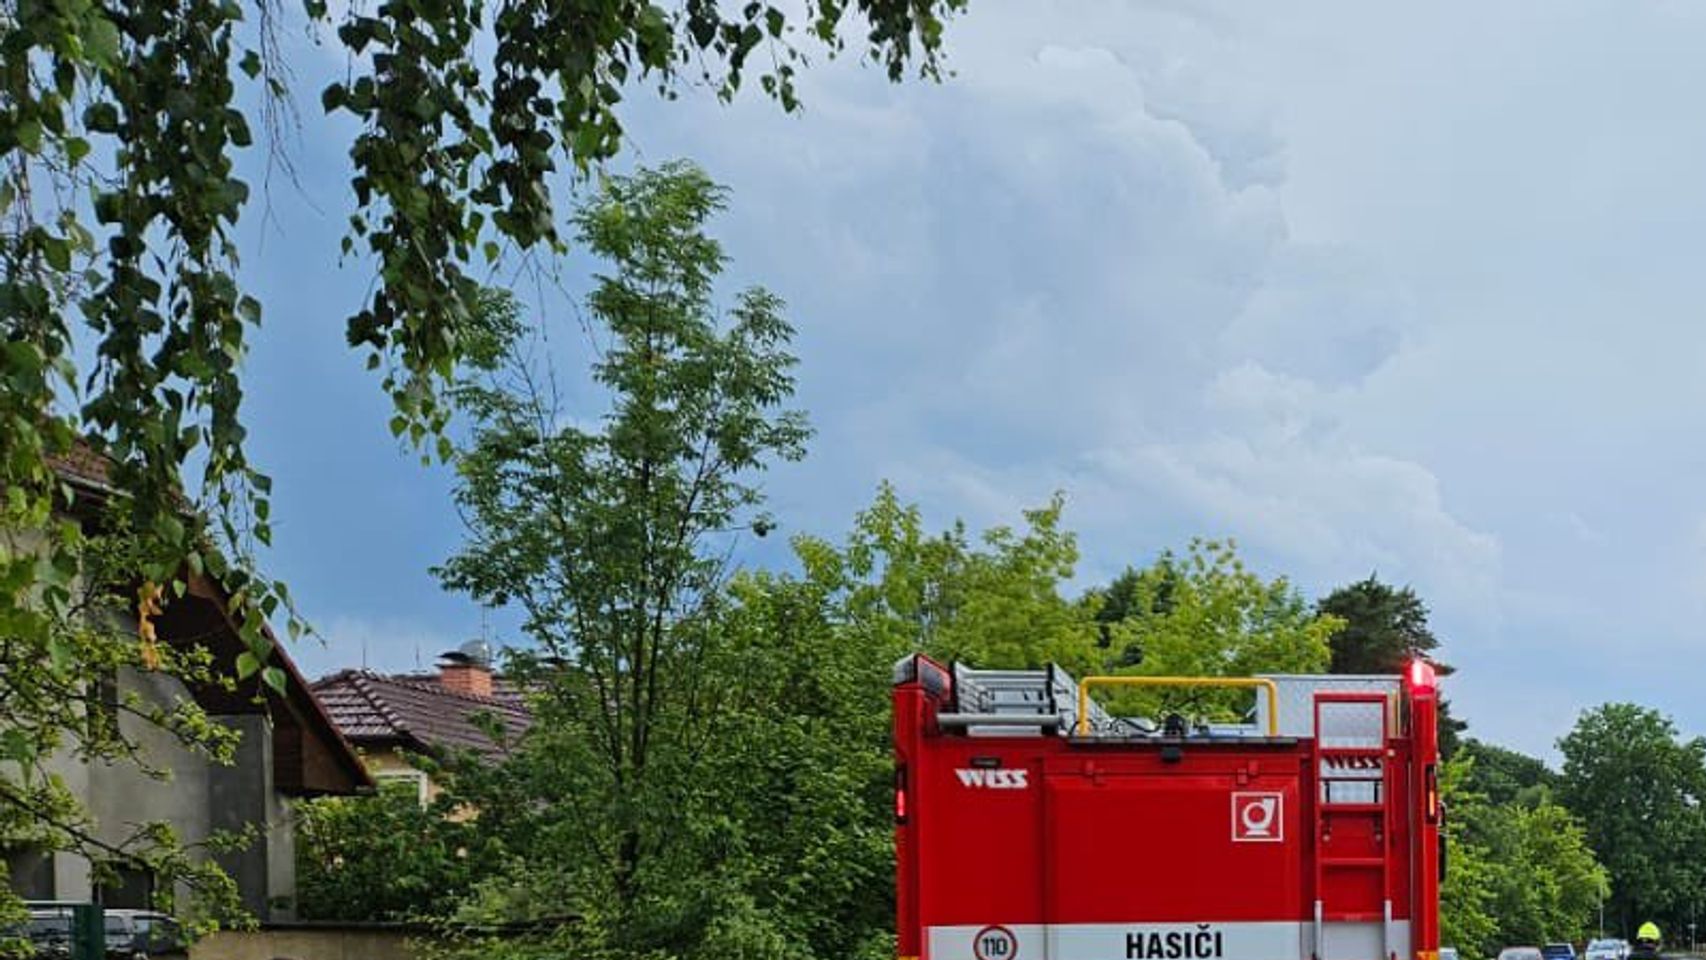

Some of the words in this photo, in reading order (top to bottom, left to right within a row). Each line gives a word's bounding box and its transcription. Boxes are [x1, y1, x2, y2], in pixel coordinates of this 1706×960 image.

[954, 768, 1029, 789] WISS
[983, 938, 1008, 956] 110
[1126, 924, 1222, 959] HASIČI
